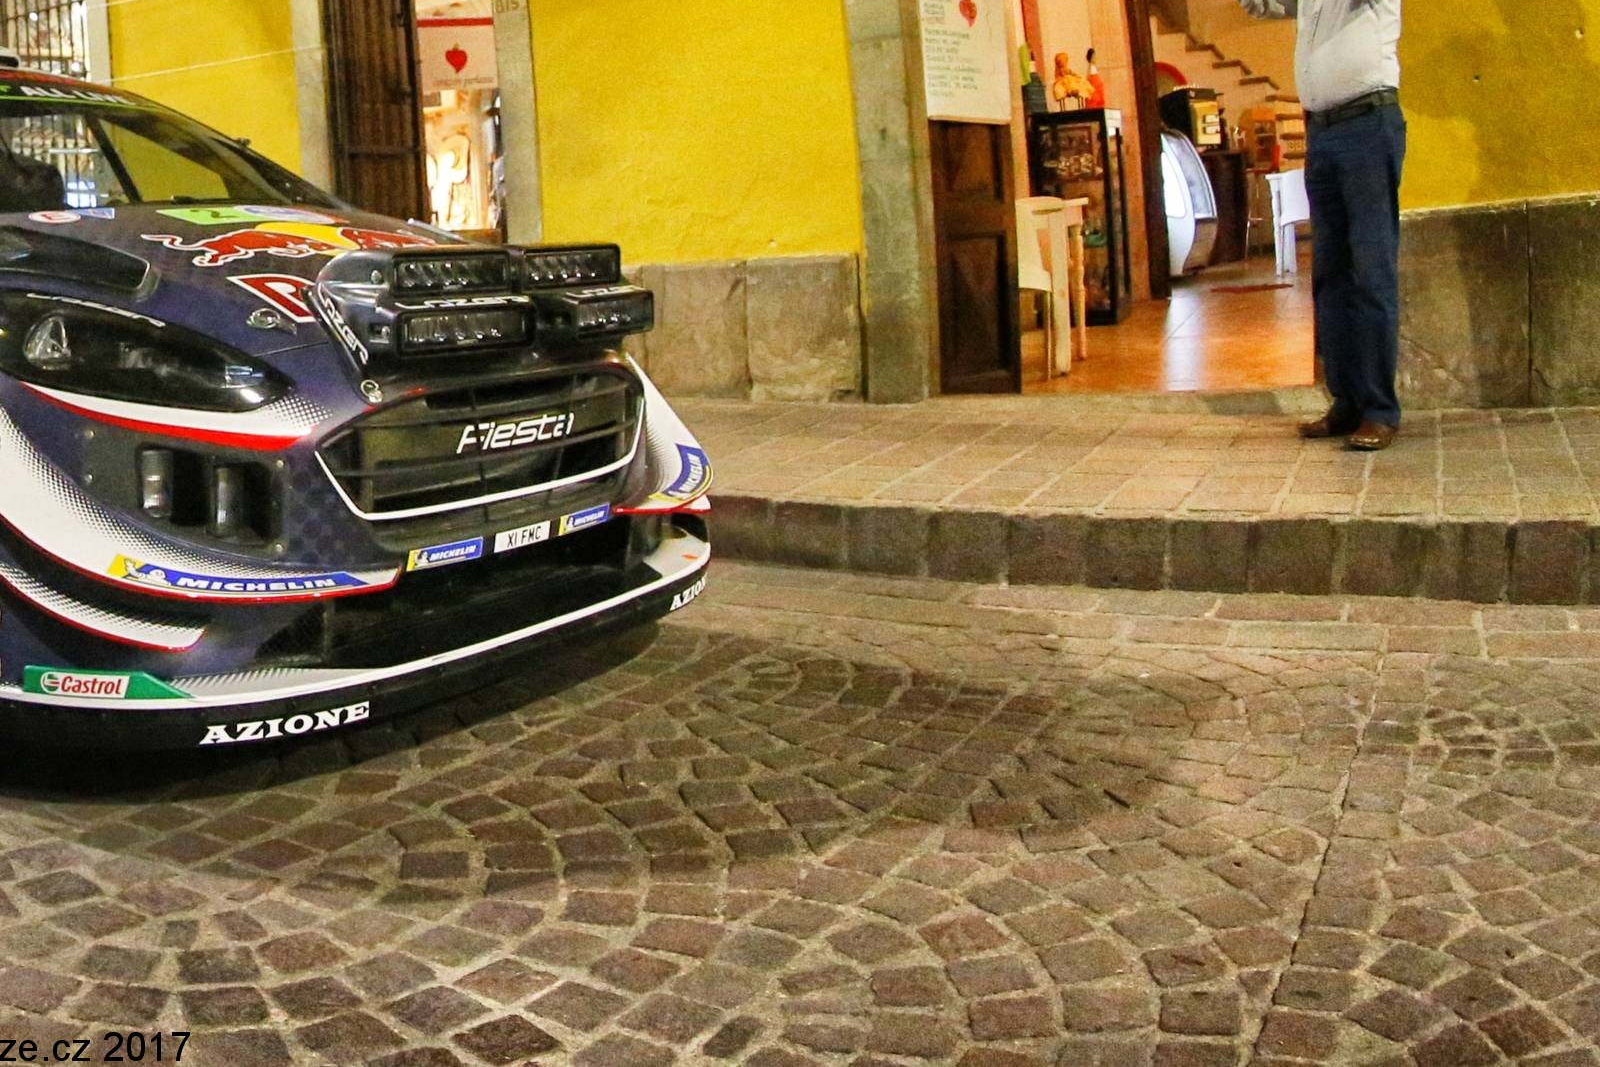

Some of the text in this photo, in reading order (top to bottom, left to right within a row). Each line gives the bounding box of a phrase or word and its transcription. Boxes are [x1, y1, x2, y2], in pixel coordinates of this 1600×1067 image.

[456, 412, 575, 454] Fiesta
[521, 526, 542, 544] FMC
[428, 544, 477, 562] MICHELIN
[175, 576, 337, 591] MICHELIN
[60, 675, 123, 695] Castrol
[198, 701, 370, 746] AZIONE
